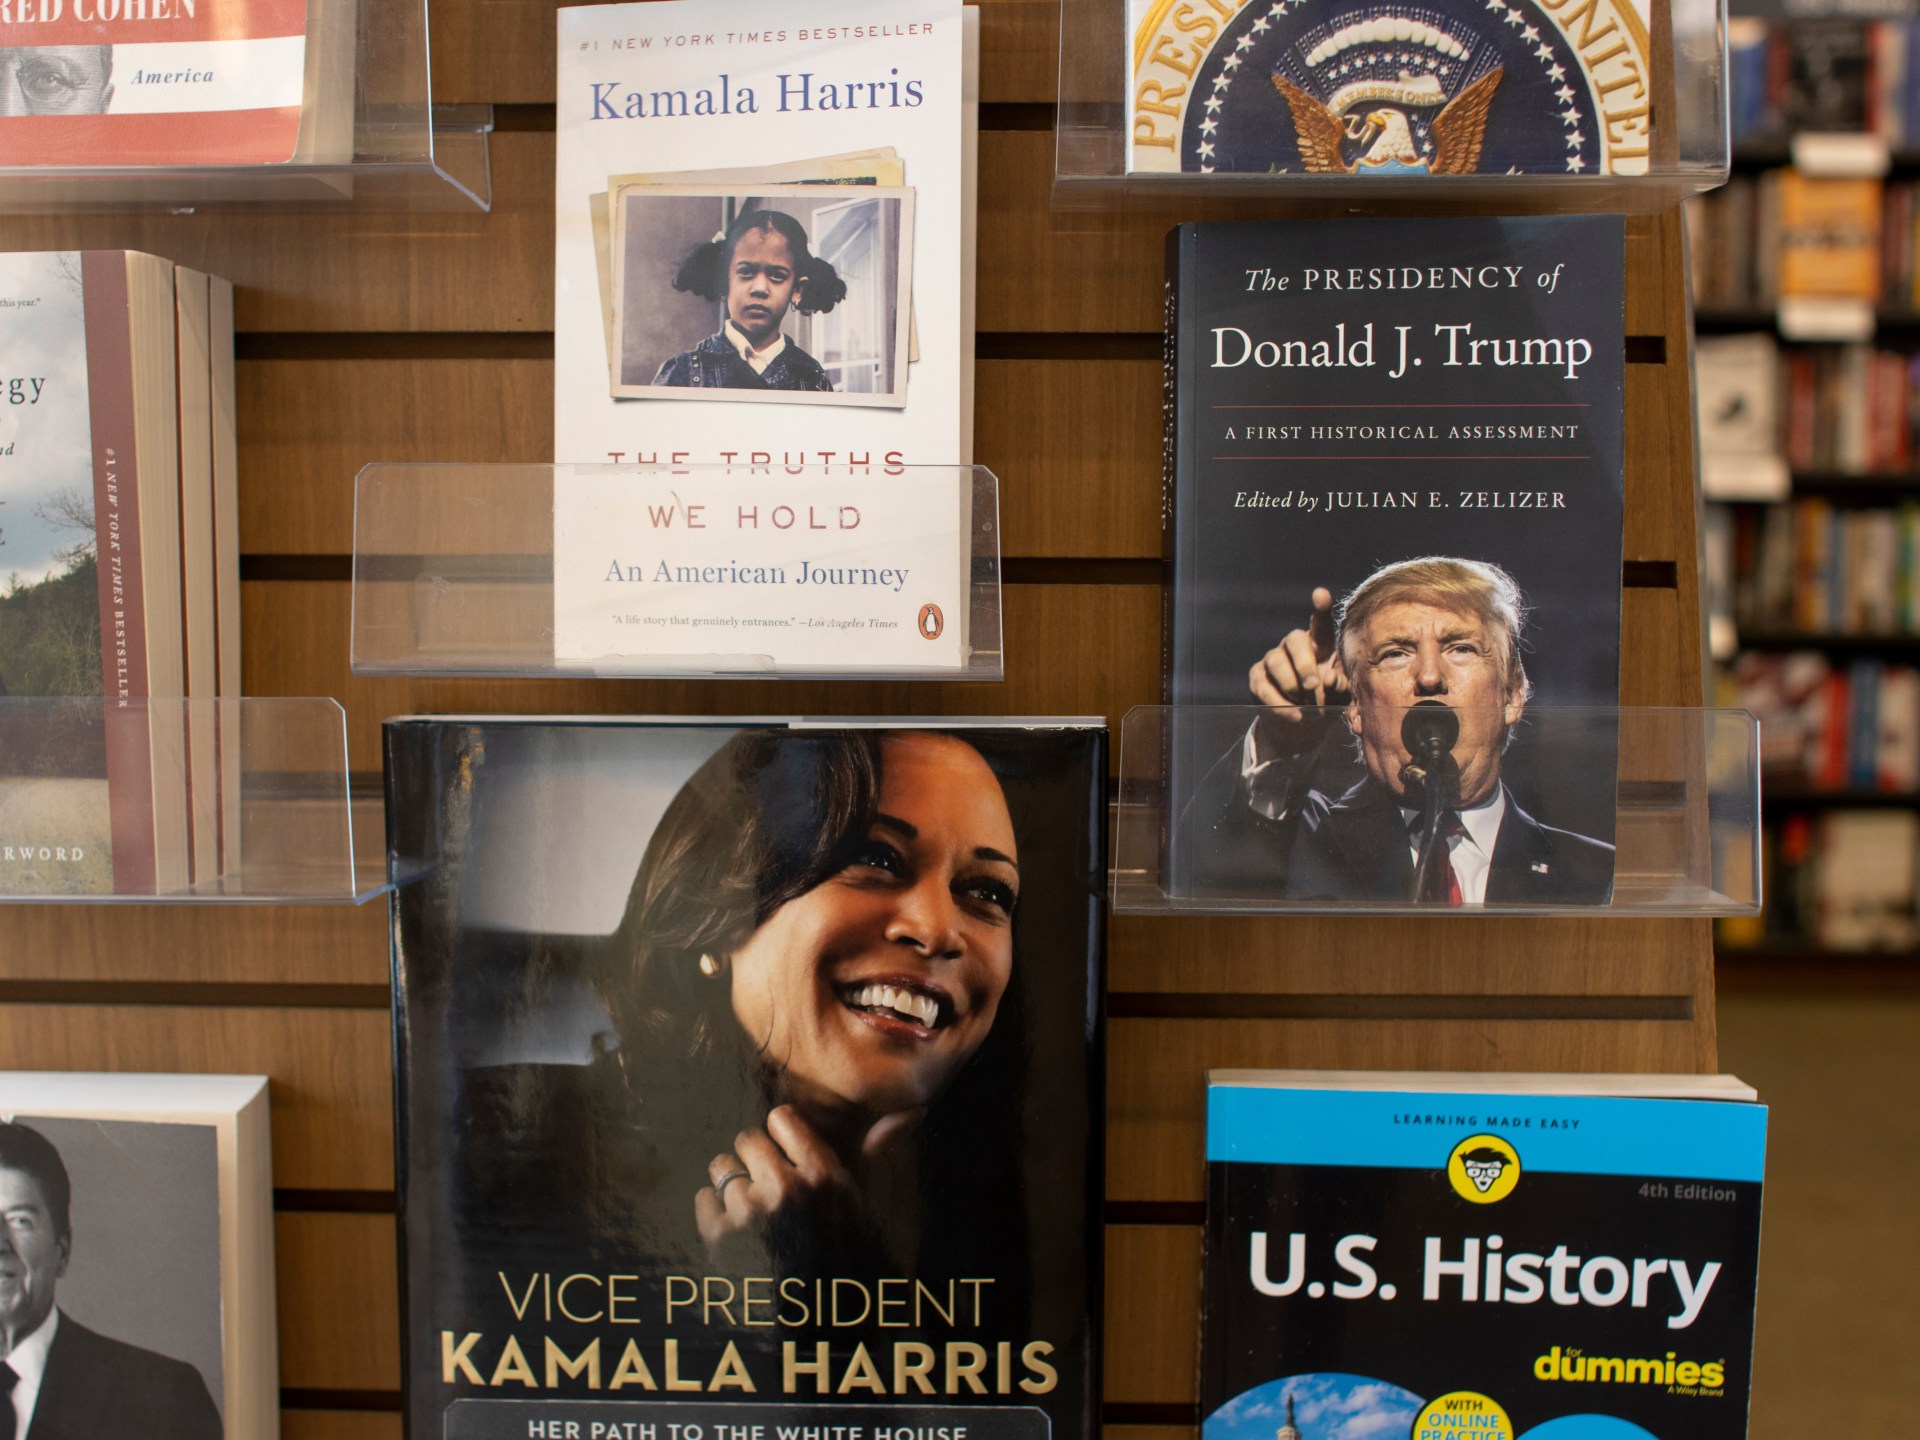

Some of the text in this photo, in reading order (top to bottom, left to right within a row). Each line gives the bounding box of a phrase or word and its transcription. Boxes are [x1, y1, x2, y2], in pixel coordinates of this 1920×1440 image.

[73, 0, 196, 22] COHEN
[580, 23, 935, 52] #1 NEW YORK TIMES BESTSELLER
[131, 68, 214, 85] America
[589, 68, 924, 121] Kamala Harris
[1245, 264, 1565, 294] The PRESIDENCY of
[1211, 323, 1593, 380] Donald J. Trump
[0, 377, 46, 405] gy
[1225, 425, 1580, 440] A FIRST HISTORICAL ASSESSMENT
[606, 451, 905, 476] THE TRUTHS
[1234, 491, 1567, 512] Edited by JULIAN E. ZELIZER
[647, 504, 862, 530] WE HOLD
[105, 447, 129, 709] #1 NEW YORK TIMES BESTSELLER
[603, 559, 910, 592] An American Journey
[626, 614, 641, 625] life
[643, 615, 667, 627] story
[670, 615, 689, 625] that
[692, 616, 739, 629] genuinely
[742, 617, 796, 627] entrances.”
[827, 618, 865, 630] Angeles
[868, 619, 898, 629] Times
[1394, 1113, 1580, 1130] LEARNING MADE EASY
[1638, 1182, 1737, 1203] 4th Edition
[1250, 1232, 1722, 1330] U.S. History
[498, 1271, 995, 1327] VICE PRESIDENT
[441, 1330, 1059, 1395] KAMALA HARRIS
[1534, 1346, 1725, 1388] for dummies
[1668, 1386, 1724, 1398] A Wiley Brand
[1445, 1399, 1483, 1411] WITH
[528, 1419, 968, 1440] HER PATH TO THE WHITE HOUSE
[1428, 1412, 1499, 1429] ONLINE
[1421, 1429, 1506, 1440] PRACTICE
